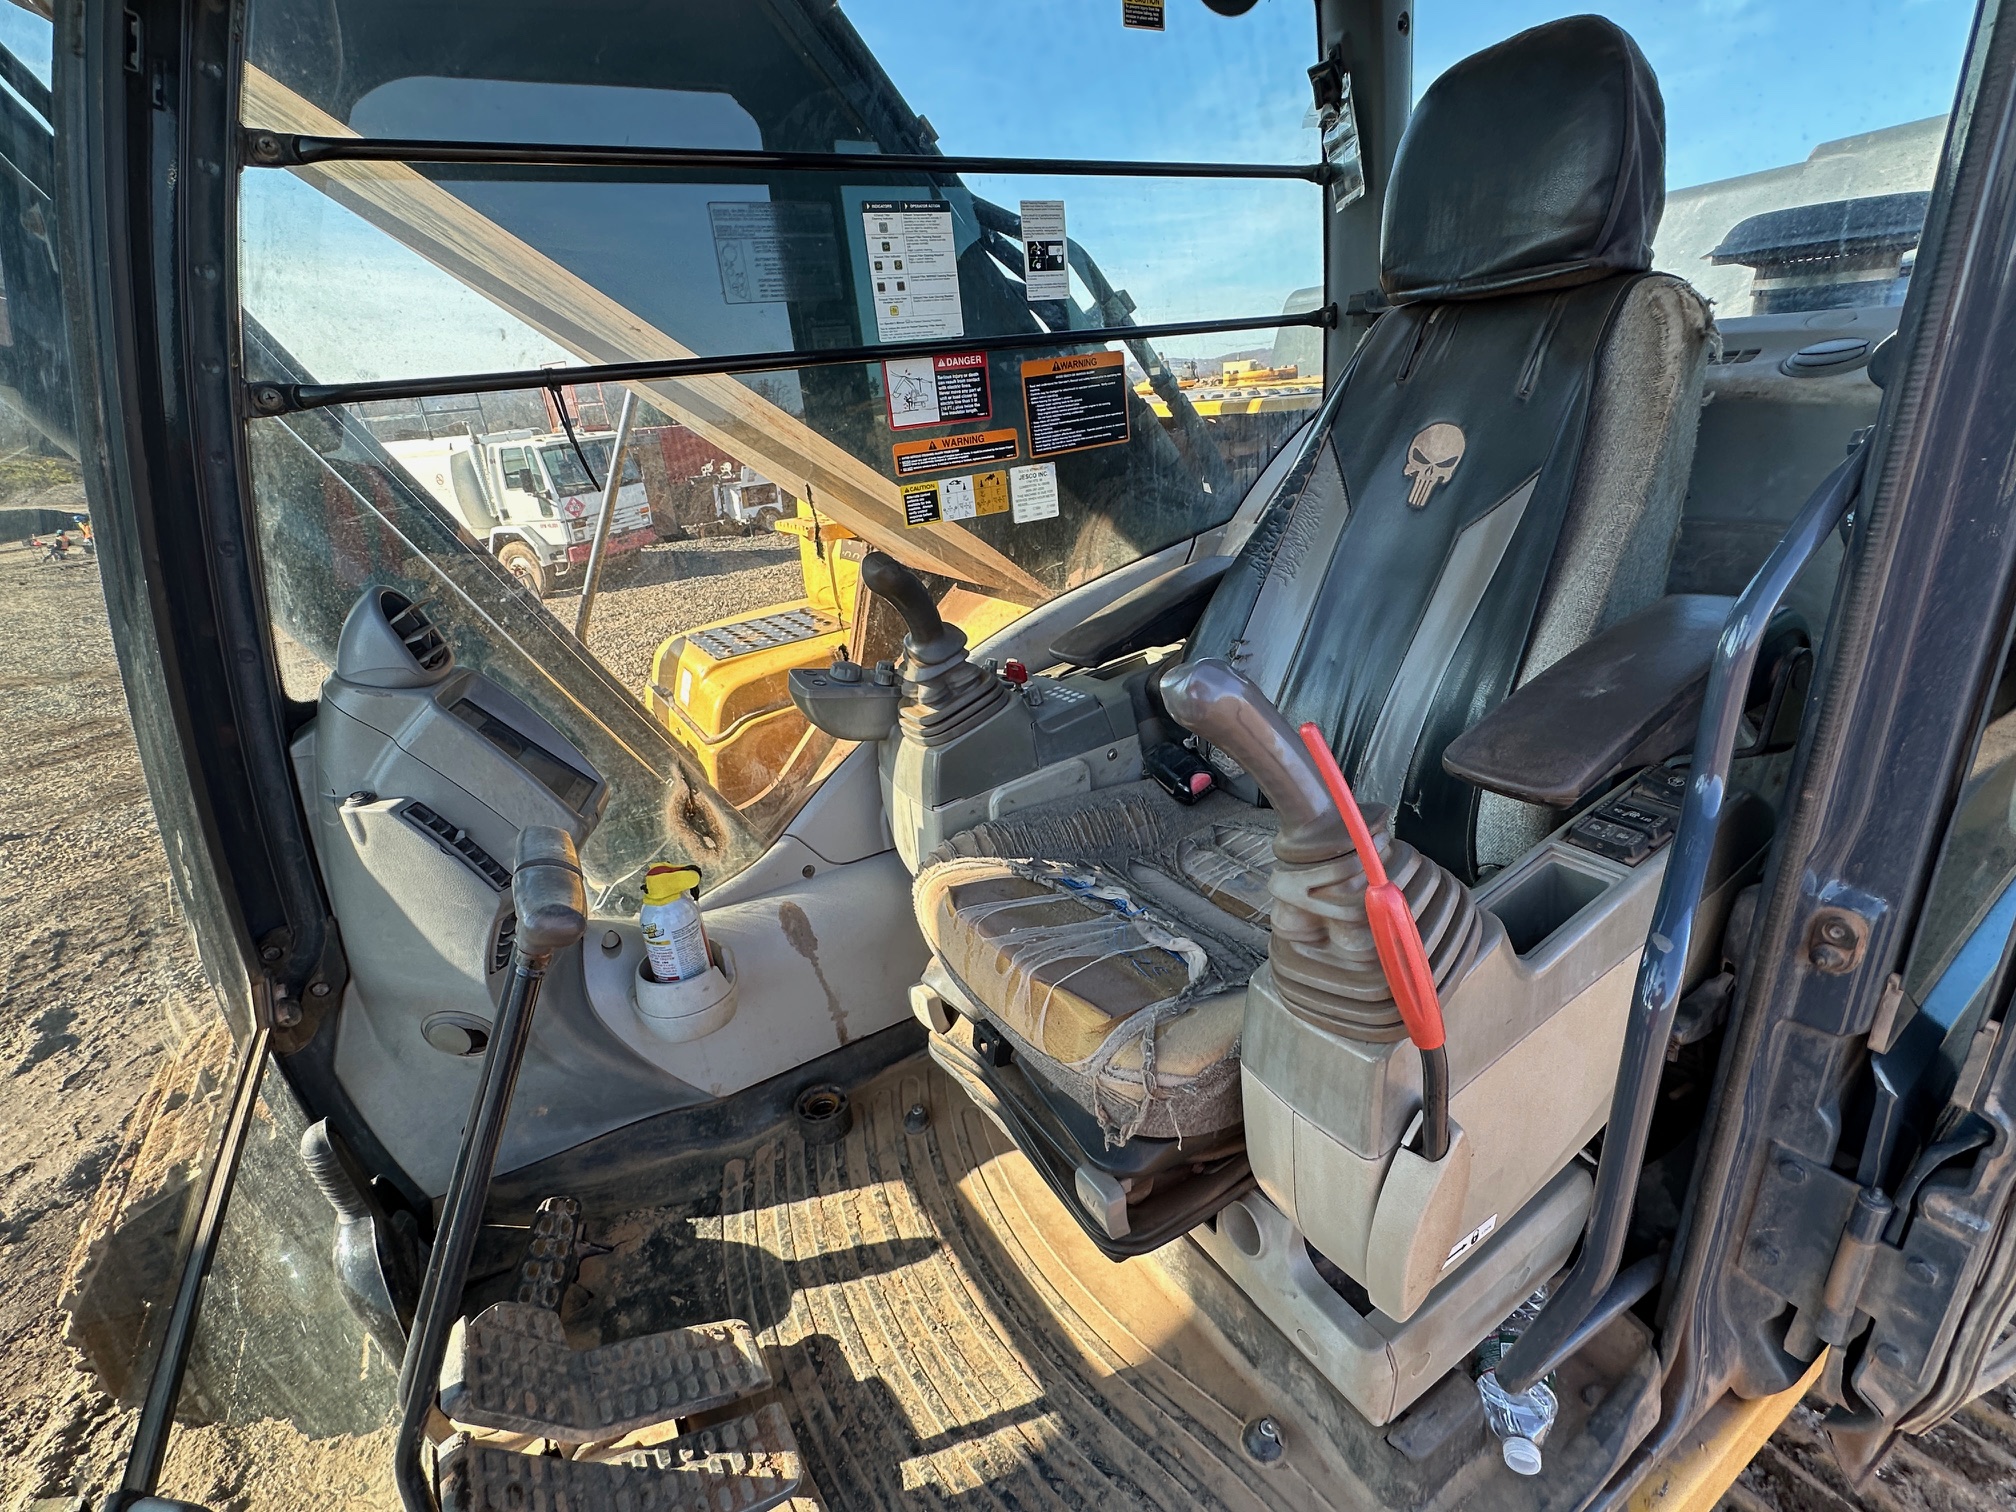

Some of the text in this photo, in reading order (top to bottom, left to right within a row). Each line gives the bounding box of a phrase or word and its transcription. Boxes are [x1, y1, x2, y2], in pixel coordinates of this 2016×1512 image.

[946, 356, 982, 366] DANGER
[1060, 358, 1097, 369] WARNING
[942, 434, 984, 448] WARNING
[910, 484, 935, 492] CAUTION
